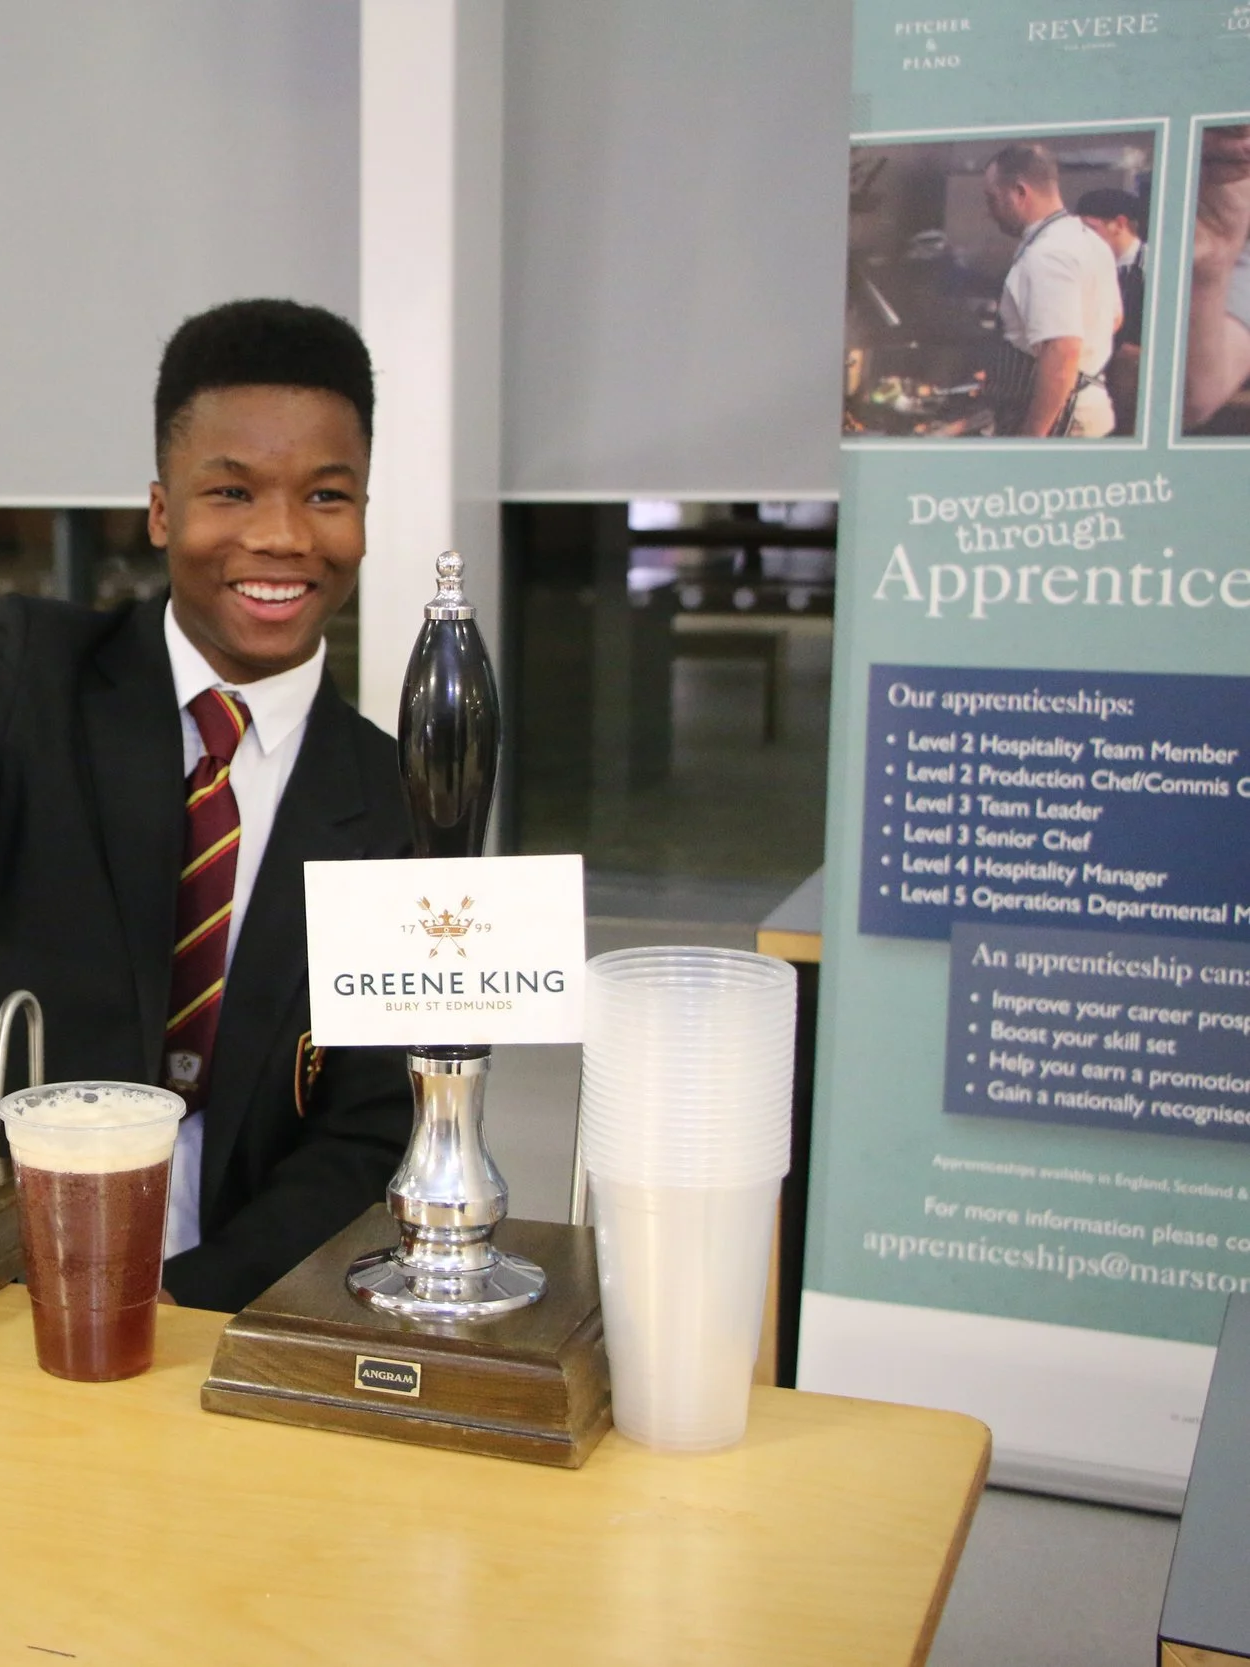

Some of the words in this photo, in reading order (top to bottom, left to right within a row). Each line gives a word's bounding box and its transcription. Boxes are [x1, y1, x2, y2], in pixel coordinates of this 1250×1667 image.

[895, 18, 971, 35] PITCHER
[1028, 12, 1159, 42] REVERE
[902, 55, 961, 71] PIANO
[908, 472, 1173, 525] Development
[955, 512, 1124, 554] through
[872, 543, 1250, 620] Apprentice
[887, 682, 934, 709] Our
[941, 688, 1135, 721] apprenticeships:
[907, 730, 956, 753] Level
[961, 734, 974, 753] 2
[980, 734, 1084, 762] Hospitality
[1090, 738, 1143, 760] Team
[1151, 741, 1238, 766] Member
[906, 761, 955, 784] Level
[960, 764, 973, 784] 2
[979, 764, 1085, 790] Production
[1091, 768, 1230, 797] Chef/Commis
[905, 792, 953, 814] Level
[958, 794, 971, 815] 3
[978, 795, 1030, 818] Team
[1035, 798, 1103, 822] Leader
[903, 822, 952, 845] Level
[957, 825, 970, 845] 3
[975, 825, 1038, 850] Senior
[1042, 829, 1093, 852] Chef
[902, 852, 950, 875] Level
[955, 854, 969, 875] 4
[974, 856, 1077, 887] Hospitality
[1082, 863, 1168, 892] Manager
[900, 882, 949, 905] Level
[955, 885, 967, 906] 5
[972, 886, 1080, 915] Operations
[1088, 894, 1227, 925] Departmental
[971, 942, 1008, 969] An
[1014, 950, 1193, 987] apprenticeship
[333, 972, 464, 996] GREENE
[480, 970, 565, 993] KING
[386, 1001, 420, 1012] BURY
[426, 1001, 441, 1011] ST
[446, 1000, 513, 1011] EDMUNDS
[992, 990, 1071, 1017] Improve
[1076, 1002, 1122, 1021] your
[1127, 1006, 1193, 1026] career
[990, 1020, 1048, 1044] Boost
[1052, 1030, 1098, 1049] your
[1103, 1030, 1141, 1052] skill
[1146, 1035, 1177, 1055] set
[989, 1050, 1035, 1077] Help
[1039, 1059, 1076, 1079] you
[1081, 1064, 1127, 1083] earn
[1132, 1068, 1143, 1084] a
[987, 1080, 1031, 1103] Gain
[1036, 1089, 1048, 1104] a
[1053, 1089, 1145, 1119] nationally
[924, 1195, 958, 1219] For
[965, 1206, 1019, 1225] more
[1025, 1208, 1145, 1239] information
[1152, 1222, 1218, 1249] please
[361, 1368, 414, 1384] ANGRAM
